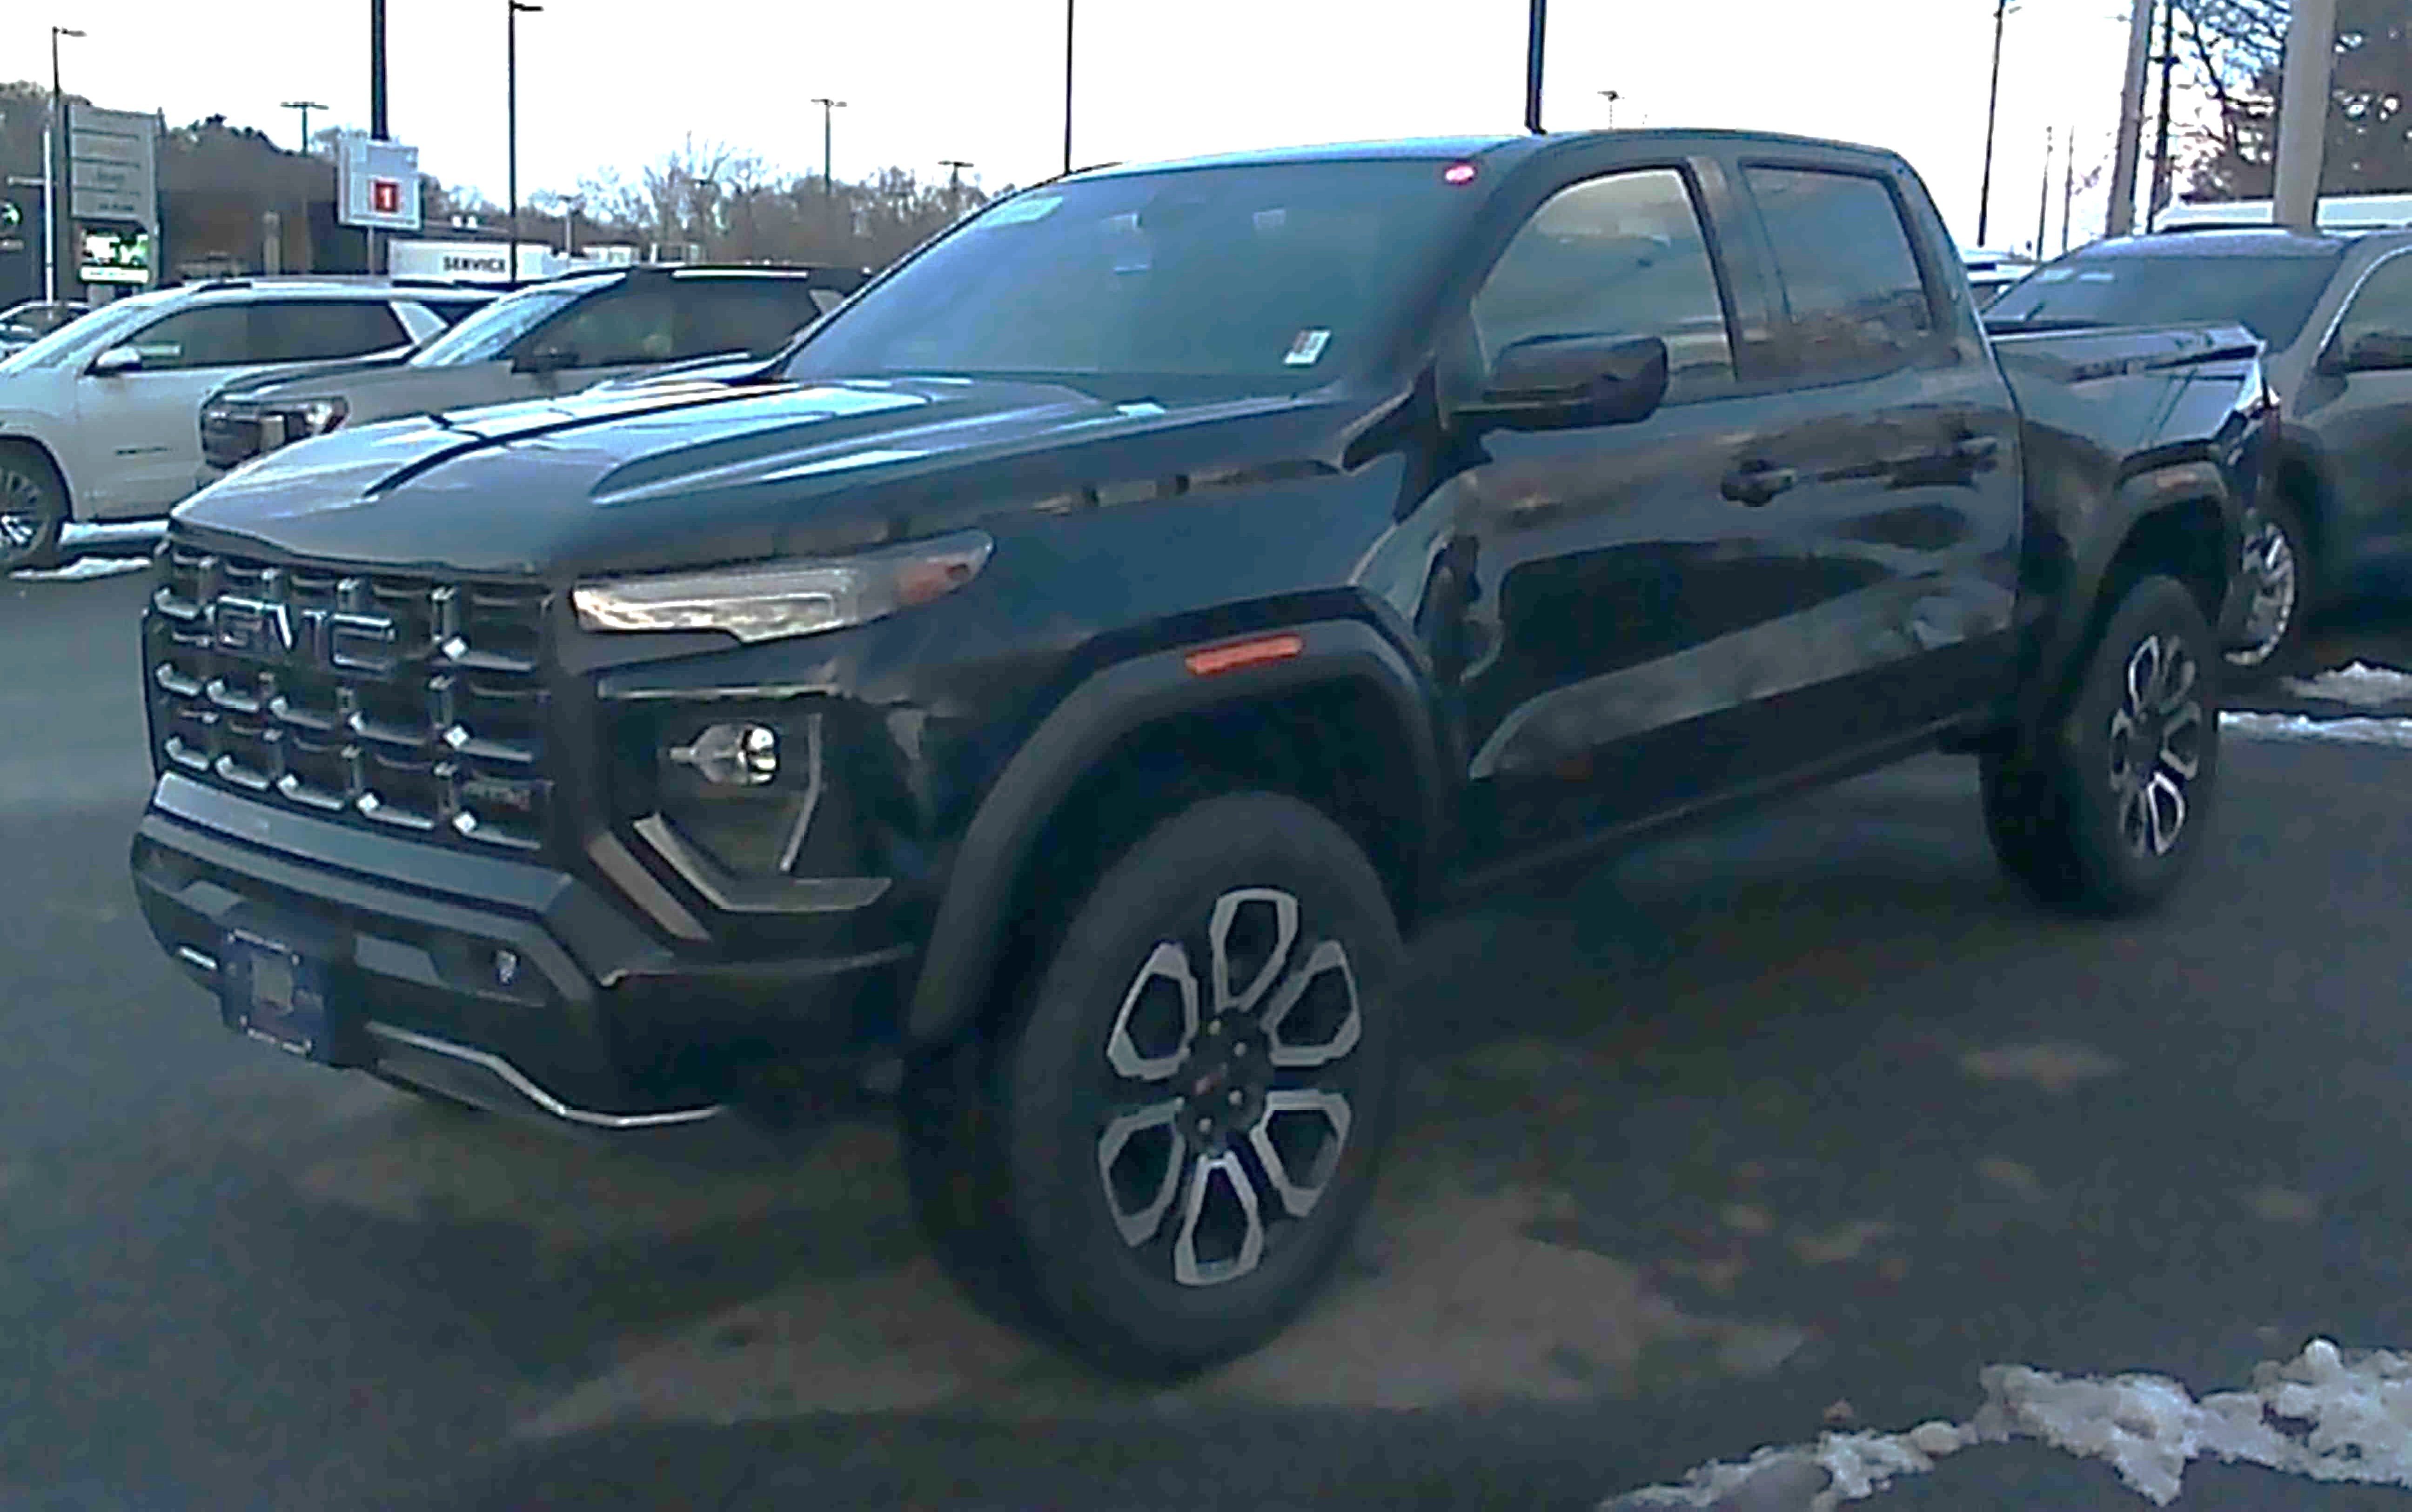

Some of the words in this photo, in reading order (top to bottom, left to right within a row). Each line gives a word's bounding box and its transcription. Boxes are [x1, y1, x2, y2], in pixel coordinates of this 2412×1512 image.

[381, 186, 392, 208] 1
[443, 256, 506, 274] SERVICE
[217, 595, 395, 673] GMC
